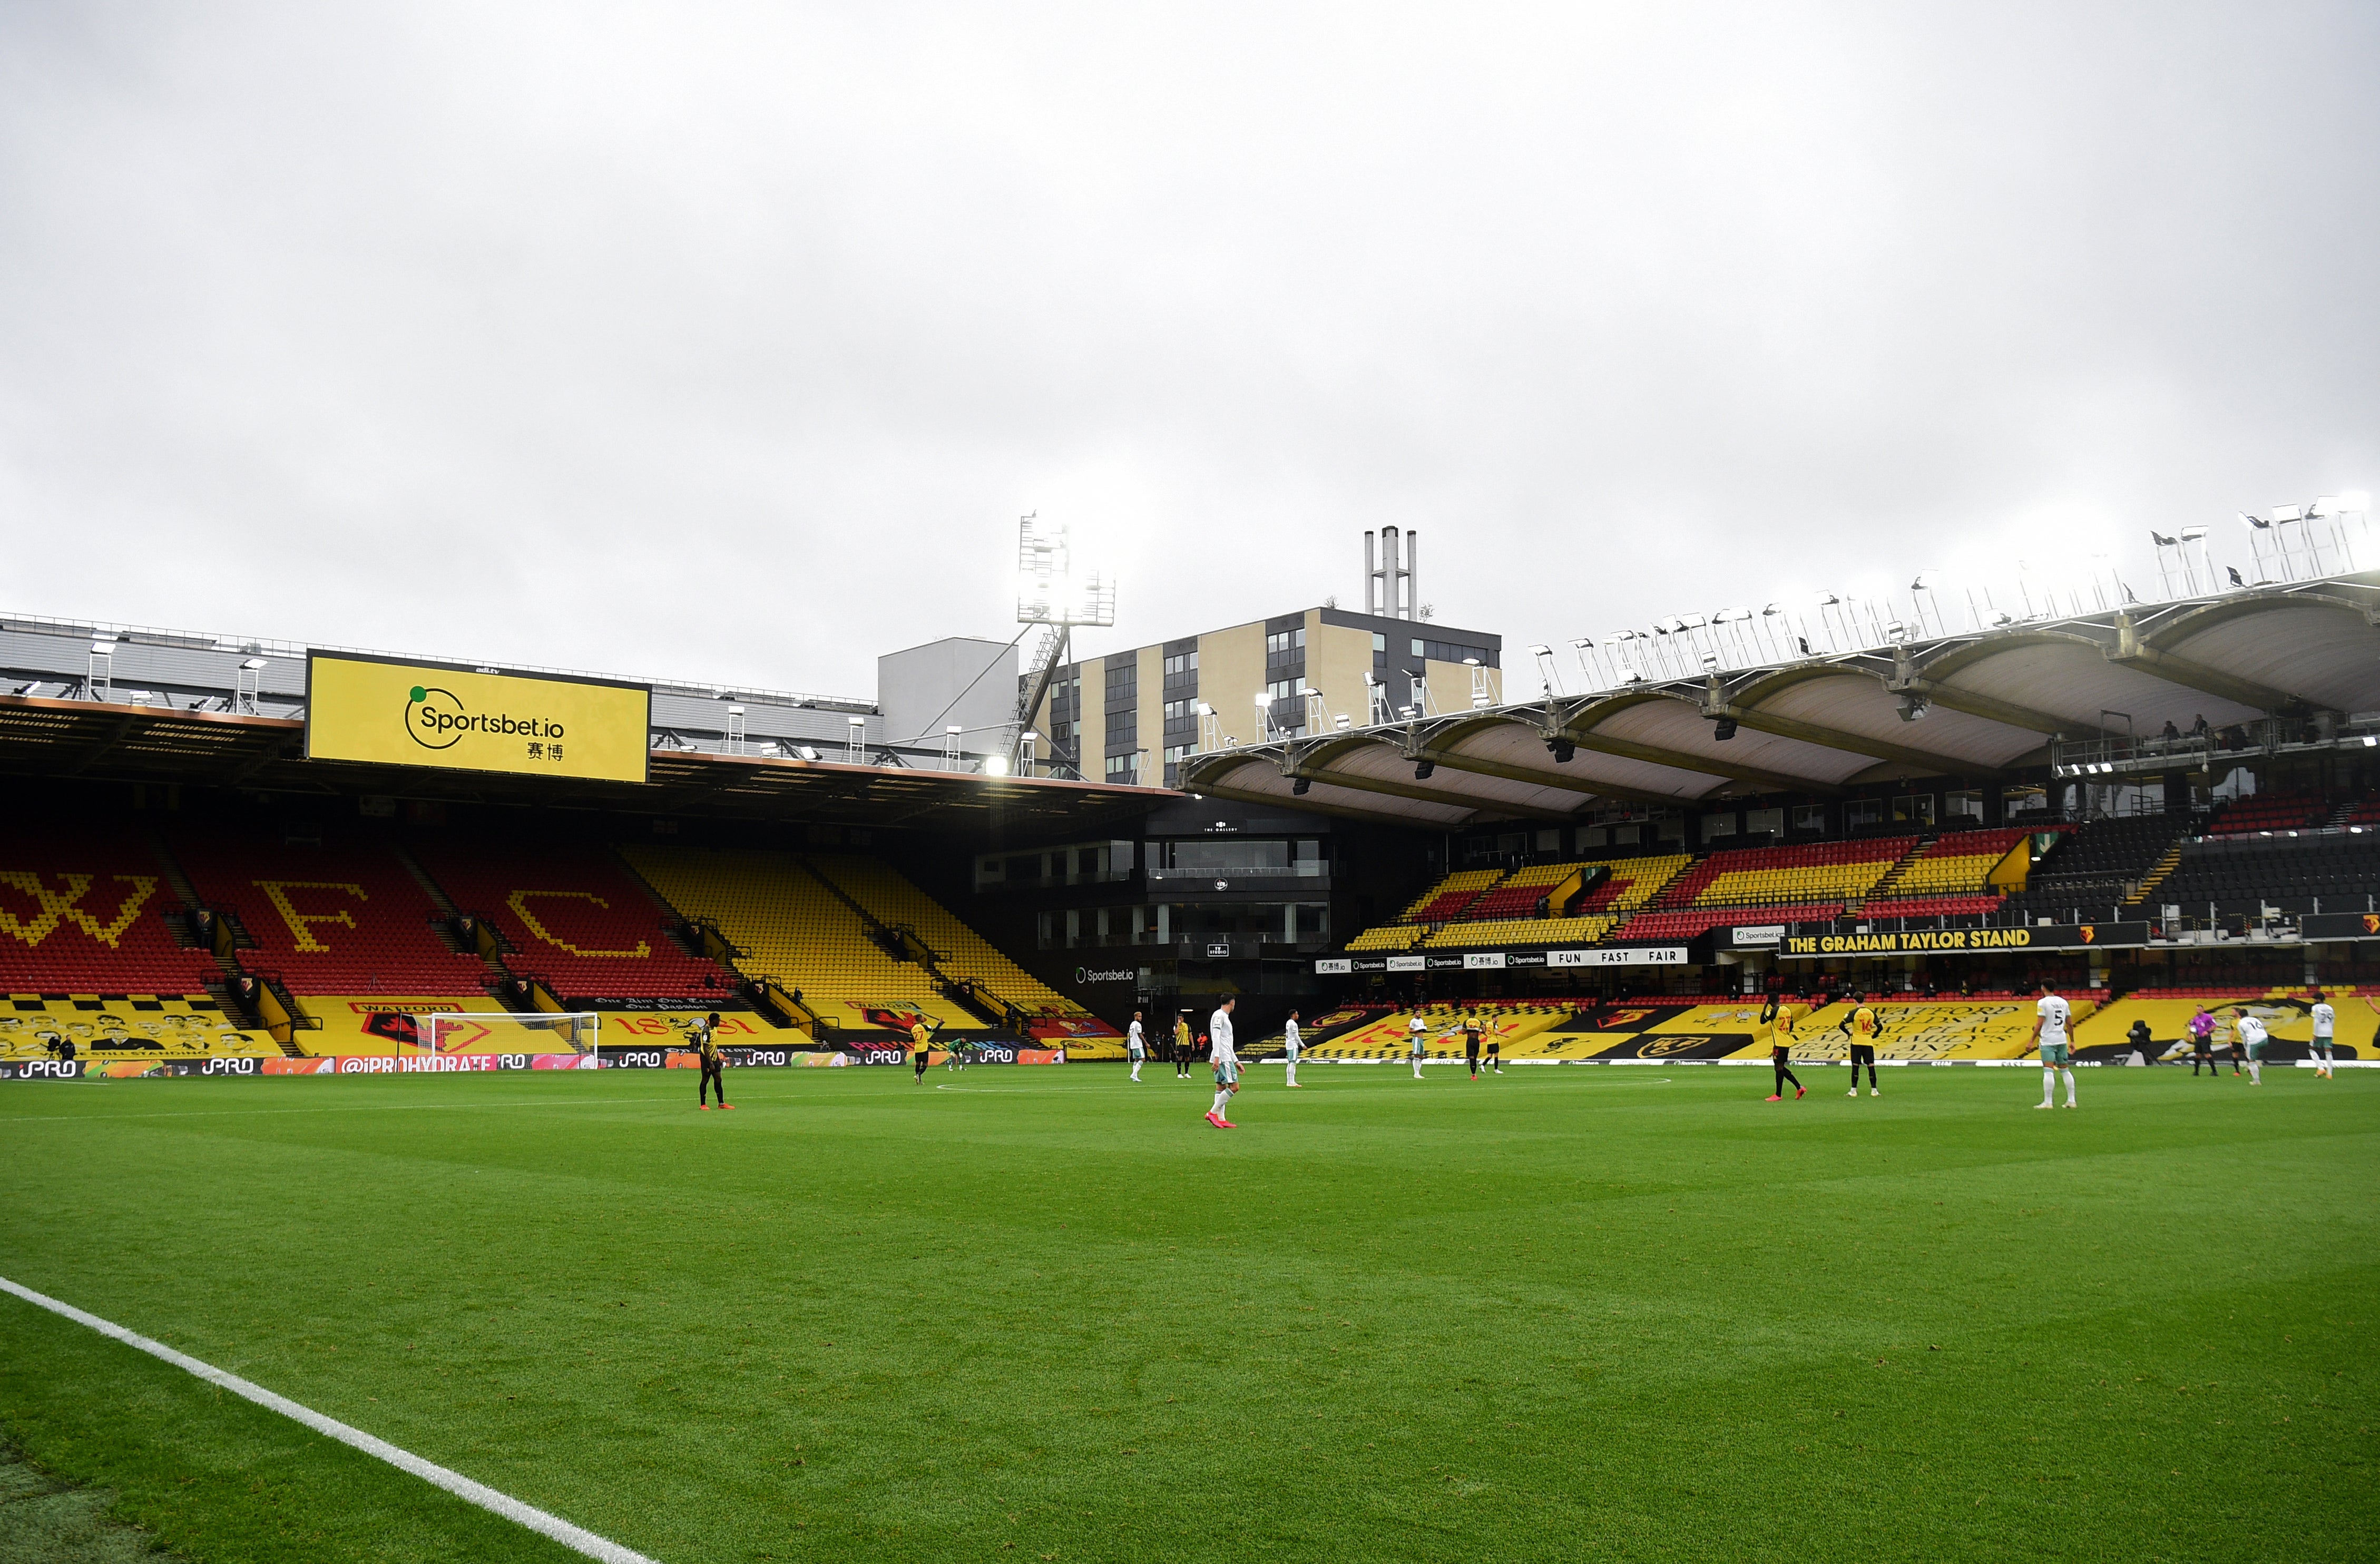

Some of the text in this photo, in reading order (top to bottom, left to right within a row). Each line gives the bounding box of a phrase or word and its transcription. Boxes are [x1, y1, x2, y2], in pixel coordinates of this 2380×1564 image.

[421, 706, 565, 739] Sportsbet.io
[527, 741, 564, 761] 赛博
[252, 880, 368, 952] F
[506, 890, 651, 958] C
[1788, 929, 2030, 953] THE GRAHAM TAYLOR STAND
[1434, 959, 1462, 967] Sportsbet.io
[1515, 955, 1545, 964] Sportsbet.io
[1559, 951, 1677, 963] FUN FAST FAIR
[1088, 969, 1133, 984] Sportsbet.io
[1874, 1006, 2019, 1015] WATFORD
[2054, 1010, 2063, 1026] 5
[913, 1030, 923, 1041] 27
[619, 1052, 660, 1068] iPRO
[747, 1051, 785, 1066] iPRO
[865, 1050, 901, 1064] iPRO
[979, 1049, 1013, 1063] iPRO
[19, 1060, 76, 1078] iPRO
[201, 1058, 253, 1075] iPRO
